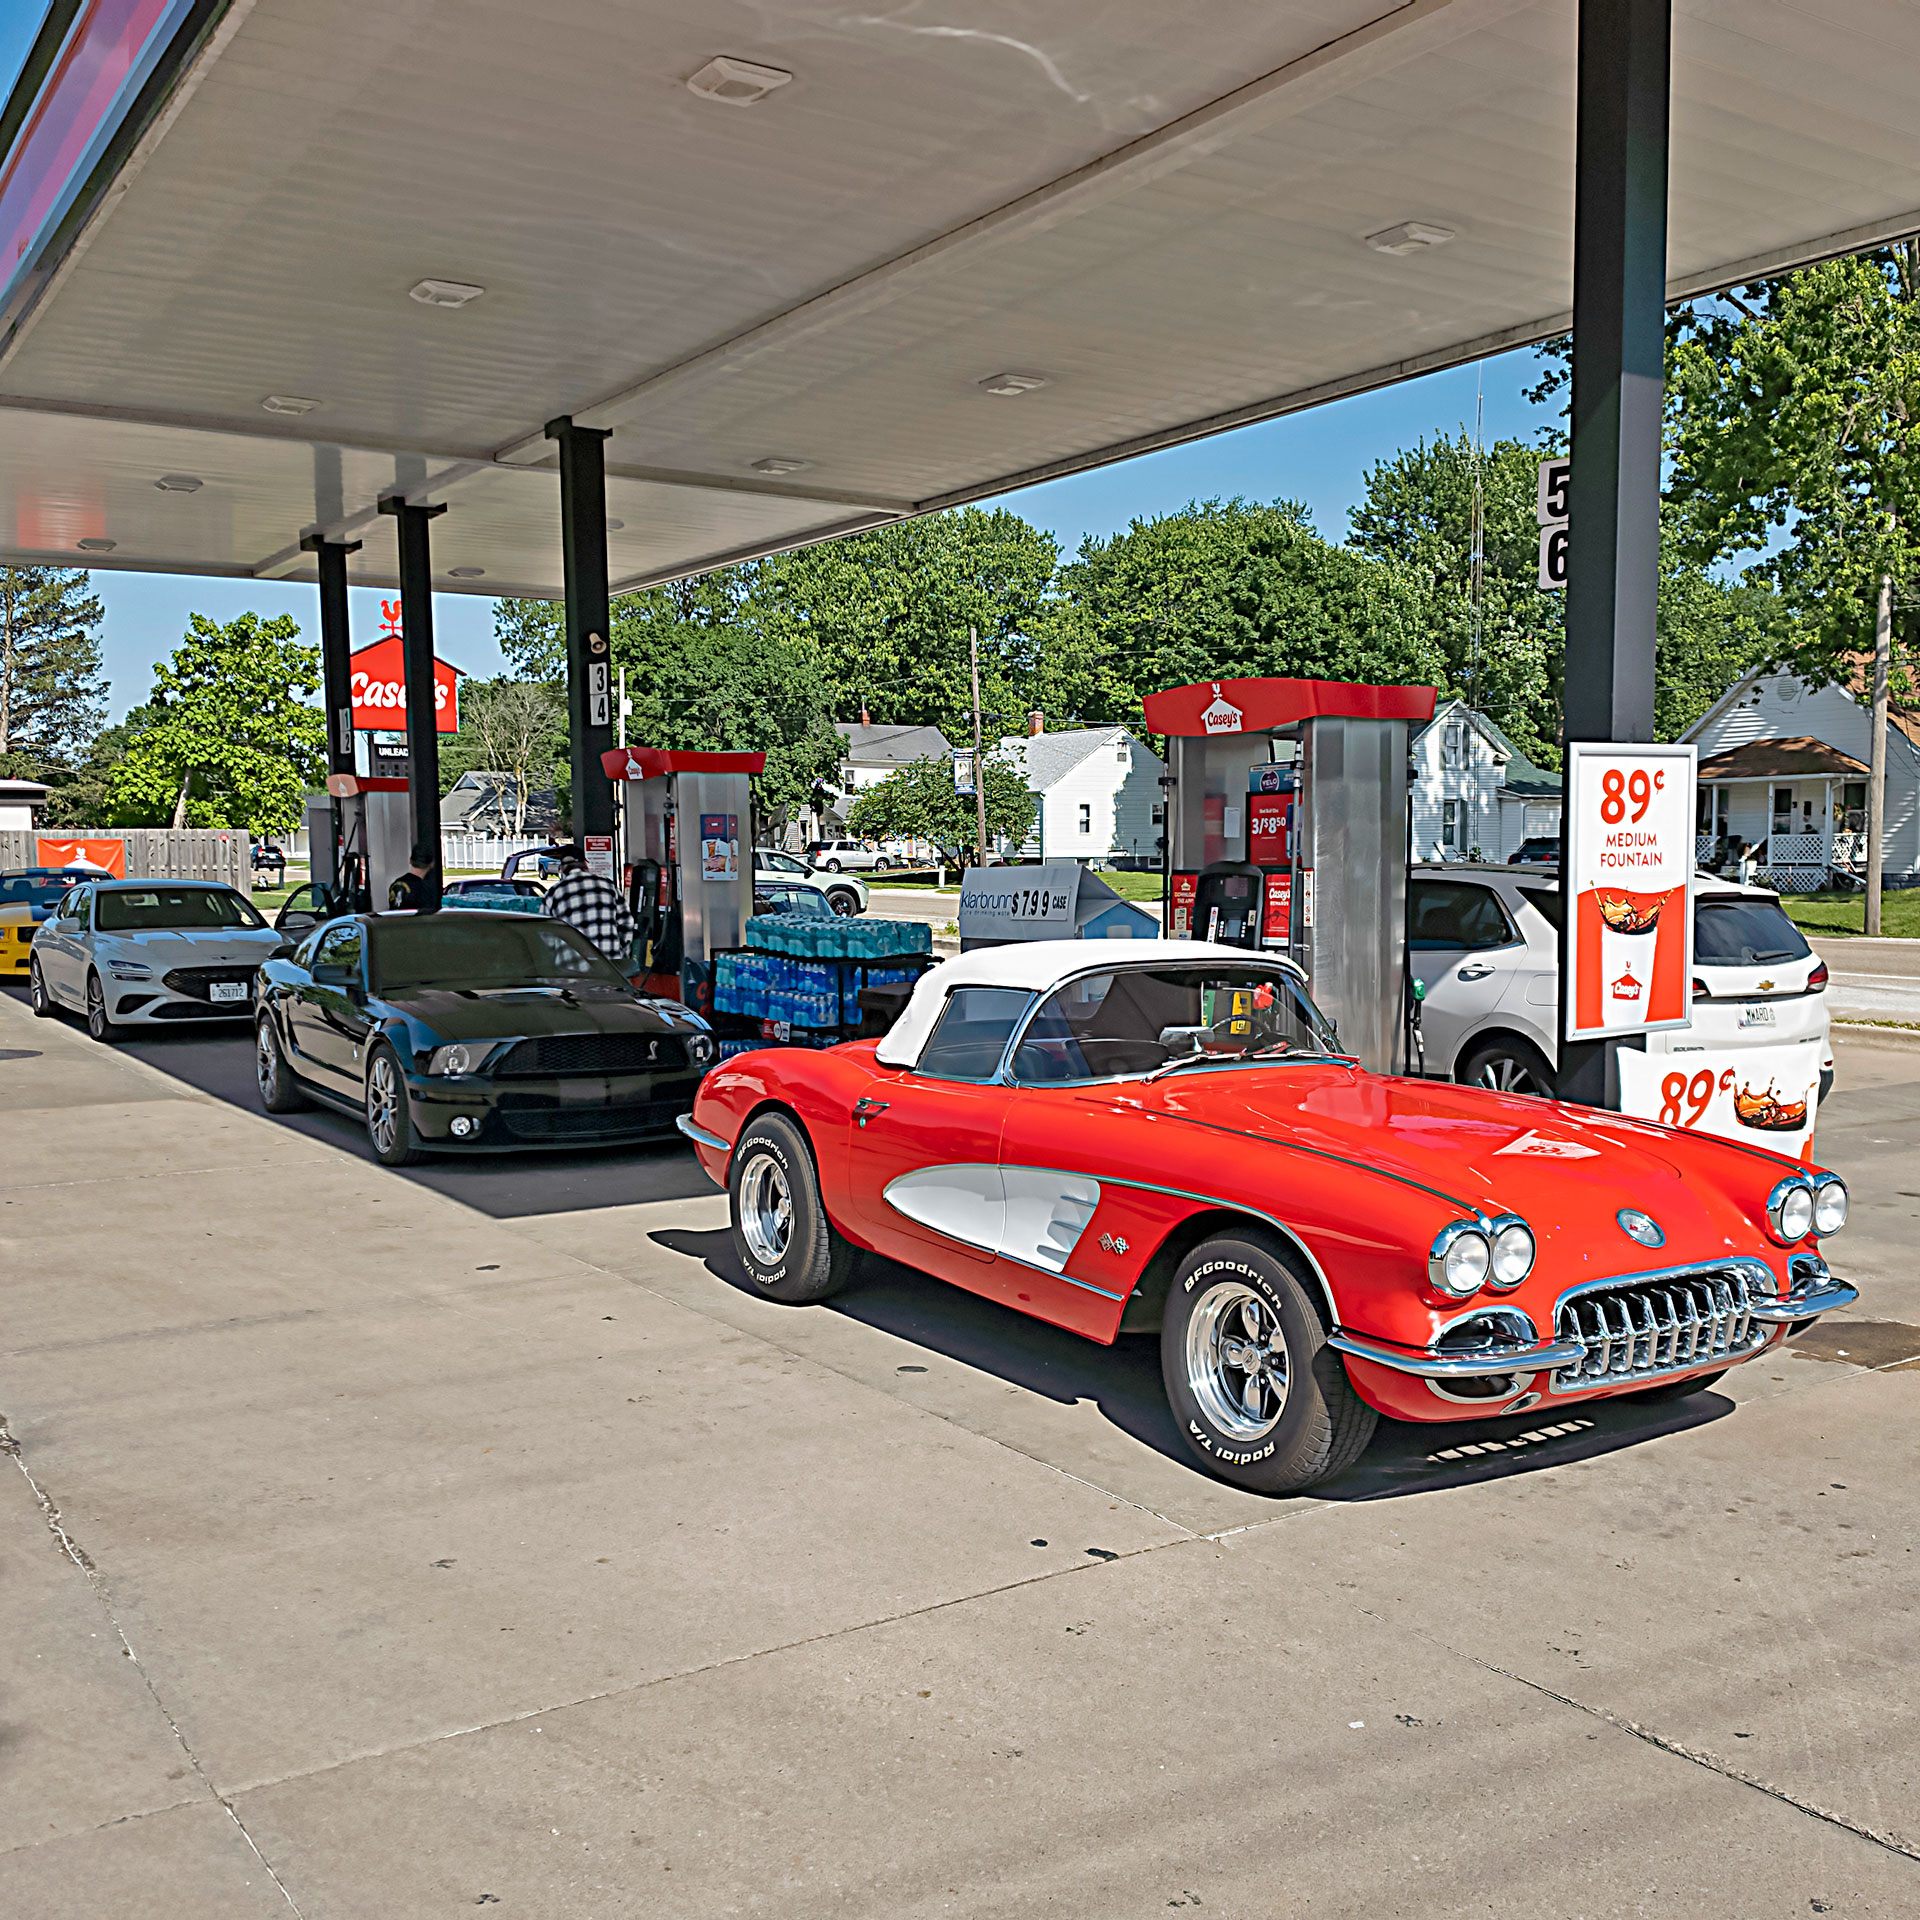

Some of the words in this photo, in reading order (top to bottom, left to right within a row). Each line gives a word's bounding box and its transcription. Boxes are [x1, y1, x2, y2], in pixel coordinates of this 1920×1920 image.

[1547, 466, 1570, 518] 5
[1547, 529, 1569, 582] 6
[351, 672, 449, 711] Case's
[597, 667, 606, 692] 3
[344, 712, 350, 729] 1
[597, 699, 606, 722] 4
[1208, 711, 1238, 728] Casey's
[378, 747, 409, 757] UNLEAD
[1606, 832, 1657, 848] MEDIUM
[1600, 852, 1663, 867] FOUNTAIN
[1052, 895, 1068, 909] CASE
[737, 1137, 789, 1171] BFGoodrich
[756, 1266, 787, 1285] Radial
[1183, 1260, 1283, 1311] BFGoodrich
[1189, 1419, 1212, 1451] T/A
[1216, 1441, 1276, 1466] Radial
